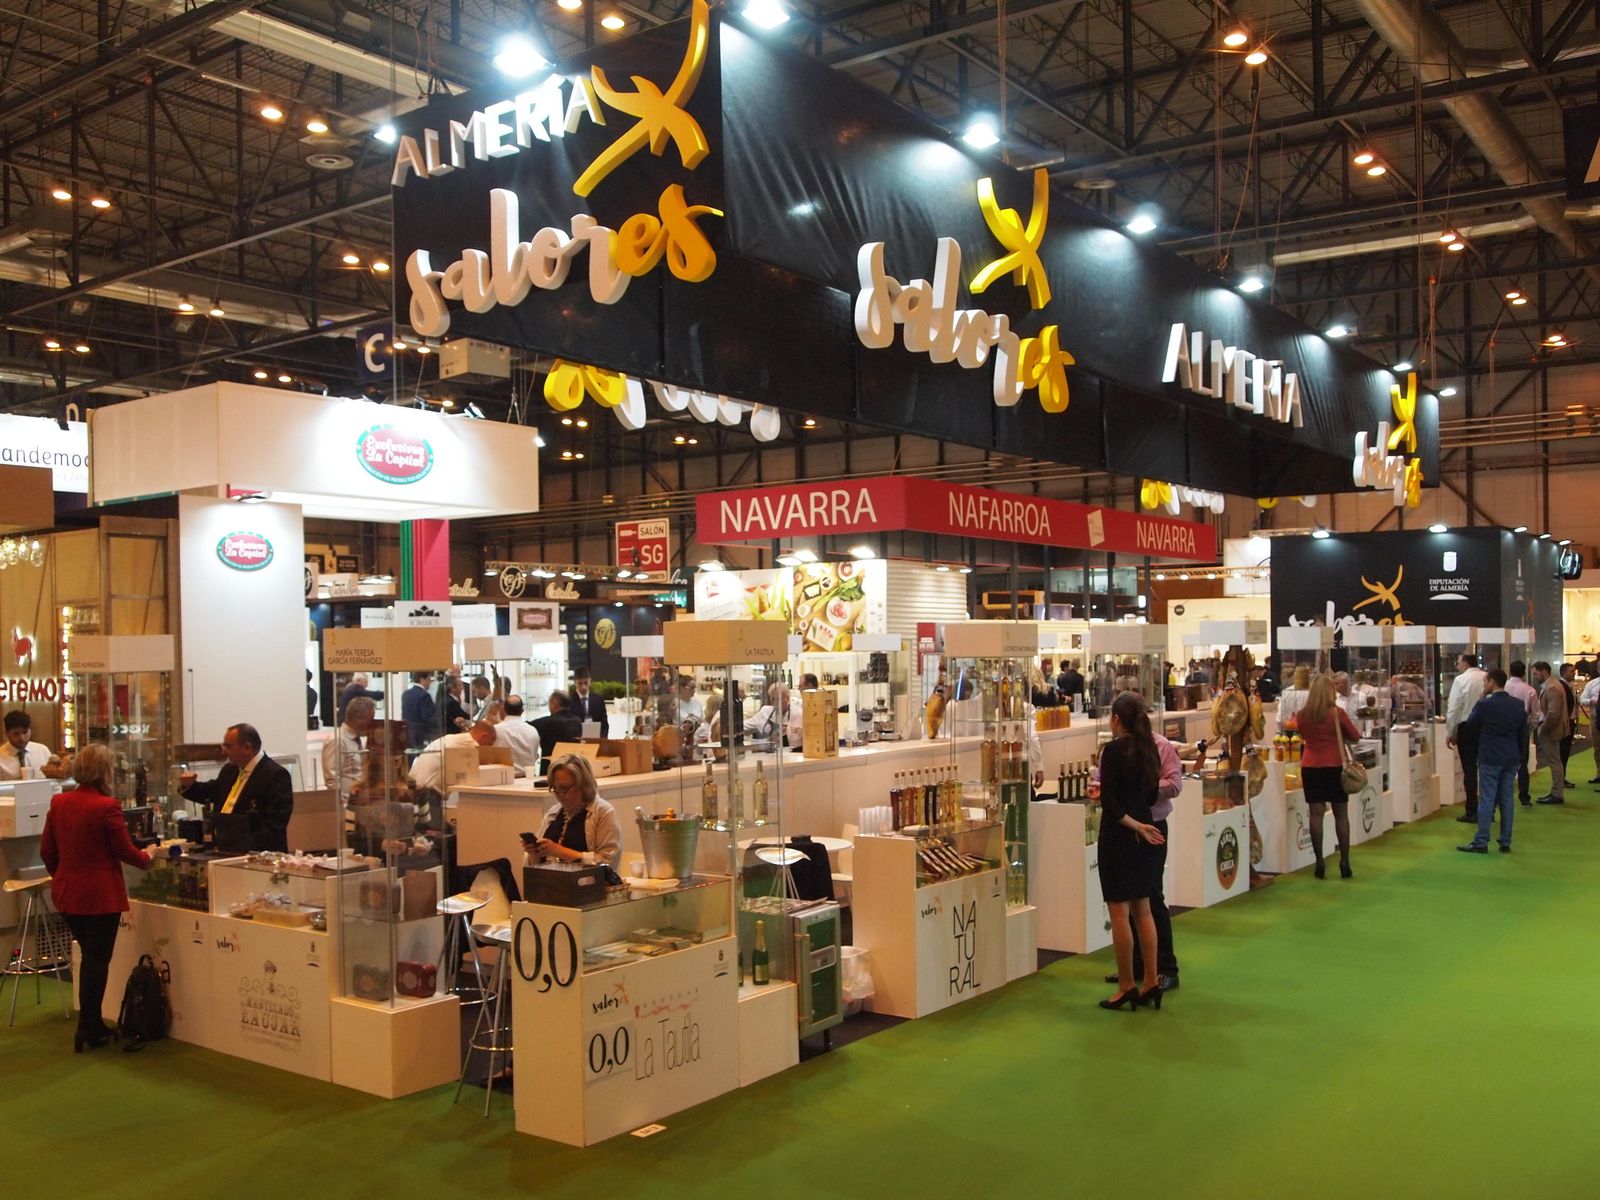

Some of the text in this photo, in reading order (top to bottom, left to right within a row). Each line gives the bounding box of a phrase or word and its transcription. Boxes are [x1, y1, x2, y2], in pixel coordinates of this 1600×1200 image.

[391, 73, 607, 187] ALMERÍA
[364, 332, 386, 373] C
[720, 487, 878, 535] NAVARRA
[948, 490, 1052, 537] NAFARROA
[640, 525, 665, 536] SALON
[1136, 519, 1197, 554] NAVARRA
[641, 544, 664, 565] SG
[1429, 577, 1470, 586] DIPUTACIÓN
[1440, 583, 1469, 592] ALMERÍA
[328, 655, 383, 665] GARCÍA FERNÁNDEZ
[335, 647, 375, 657] MARÍA TERESA
[514, 917, 578, 993] 0,0
[588, 1026, 630, 1074] 0,0
[635, 1027, 655, 1081] La
